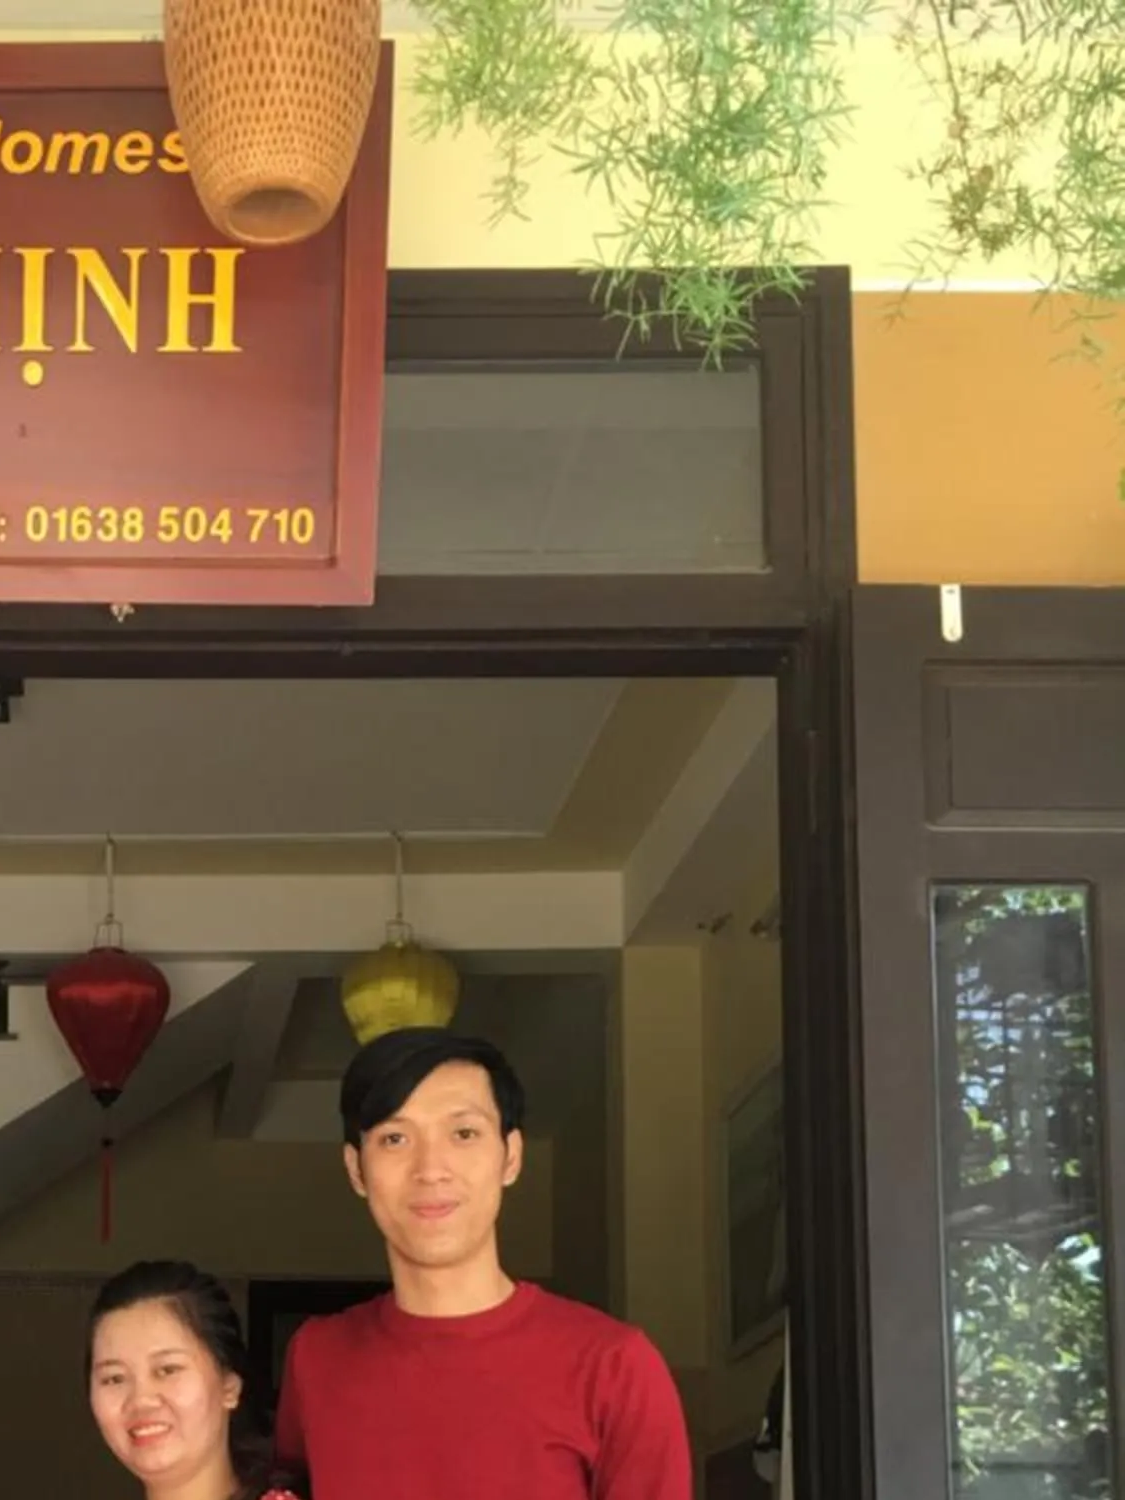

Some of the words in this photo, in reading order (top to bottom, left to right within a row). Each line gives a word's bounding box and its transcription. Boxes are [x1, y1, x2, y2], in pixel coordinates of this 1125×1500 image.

[25, 503, 145, 544] 01638
[157, 505, 233, 545] 504
[246, 507, 316, 546] 710
